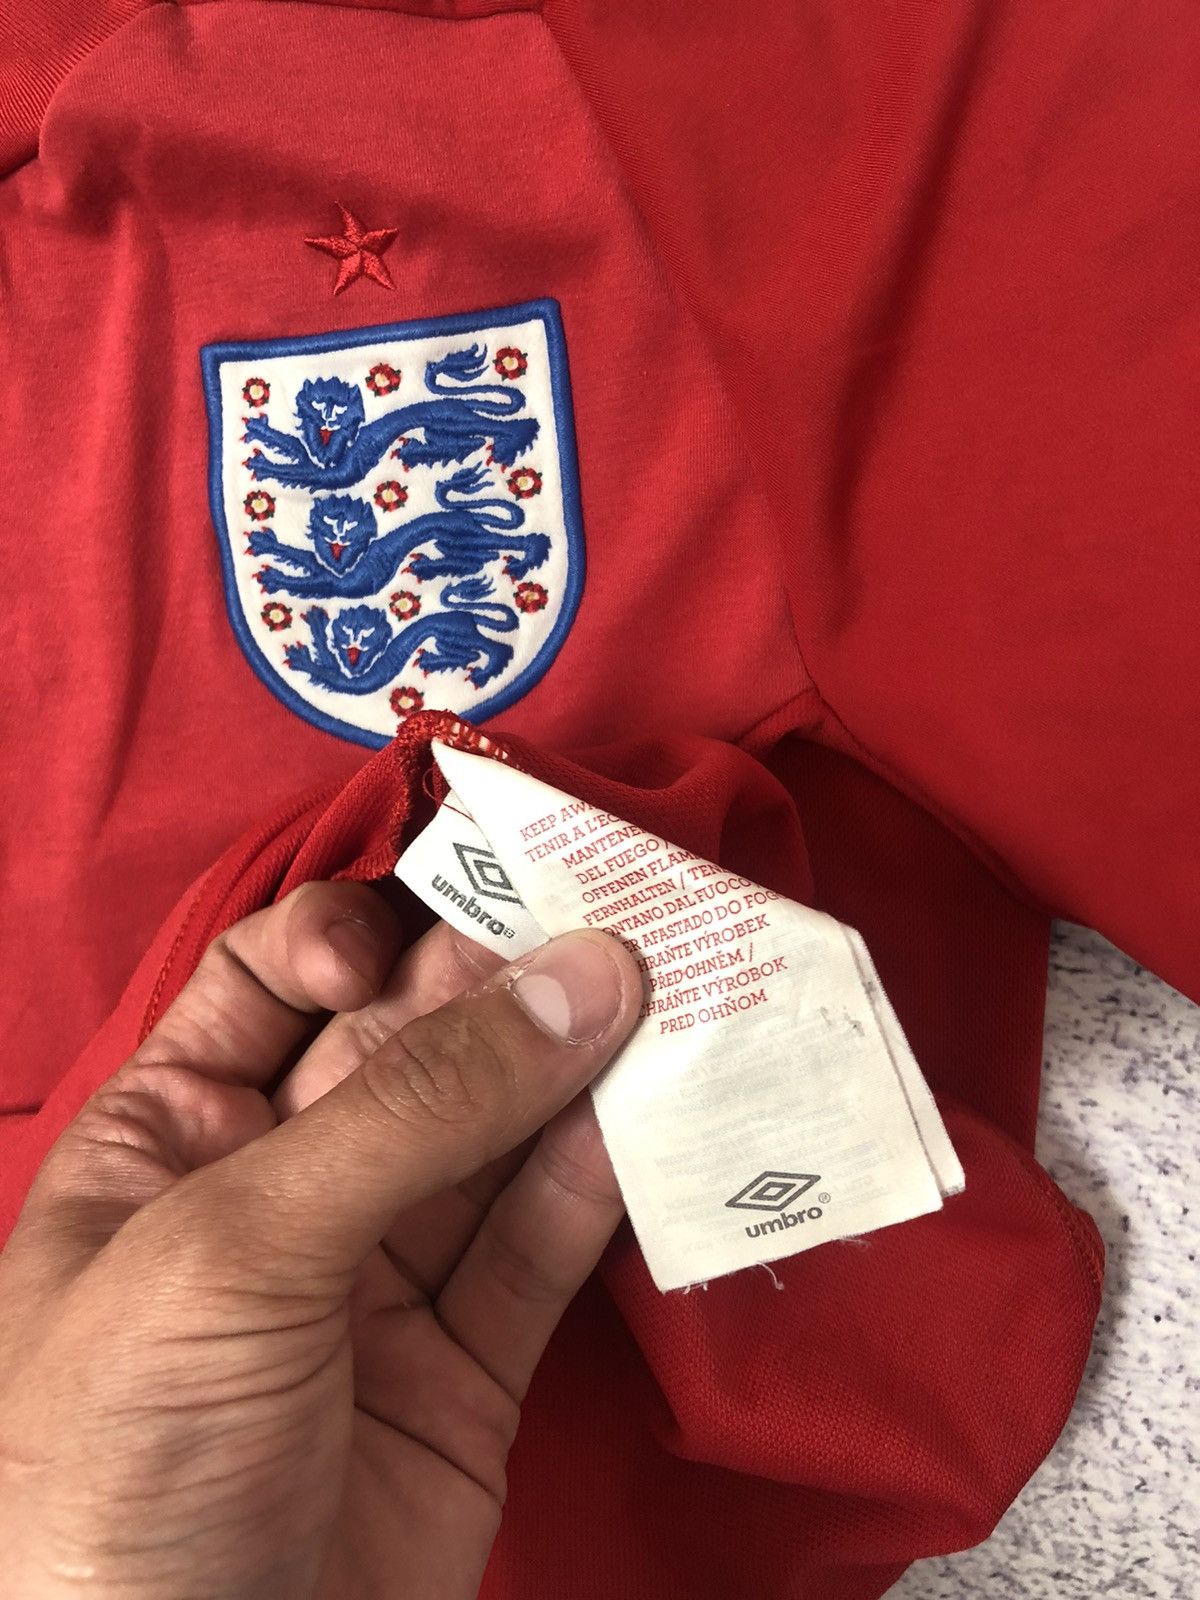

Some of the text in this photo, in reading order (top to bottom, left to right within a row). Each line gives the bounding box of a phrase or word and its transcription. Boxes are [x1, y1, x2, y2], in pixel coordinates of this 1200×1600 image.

[520, 814, 557, 842] KEEP
[525, 833, 572, 862] TENIR
[573, 826, 586, 841] A
[576, 866, 607, 885] DEL
[604, 838, 660, 873] FUEGO
[582, 850, 699, 904] OFFENEN FLAM
[583, 878, 678, 926] FERNHALTEN
[687, 863, 730, 881] TEN
[602, 877, 752, 937] ONTANO DAL FUOCO
[638, 913, 771, 973] HRAŇTE VÝROBEK
[642, 910, 713, 948] AFASTADO
[714, 899, 742, 921] DO
[685, 948, 745, 979] OHNĚM
[702, 956, 788, 997] VÝROBOK
[659, 988, 769, 1035] PRED OHŇOM
